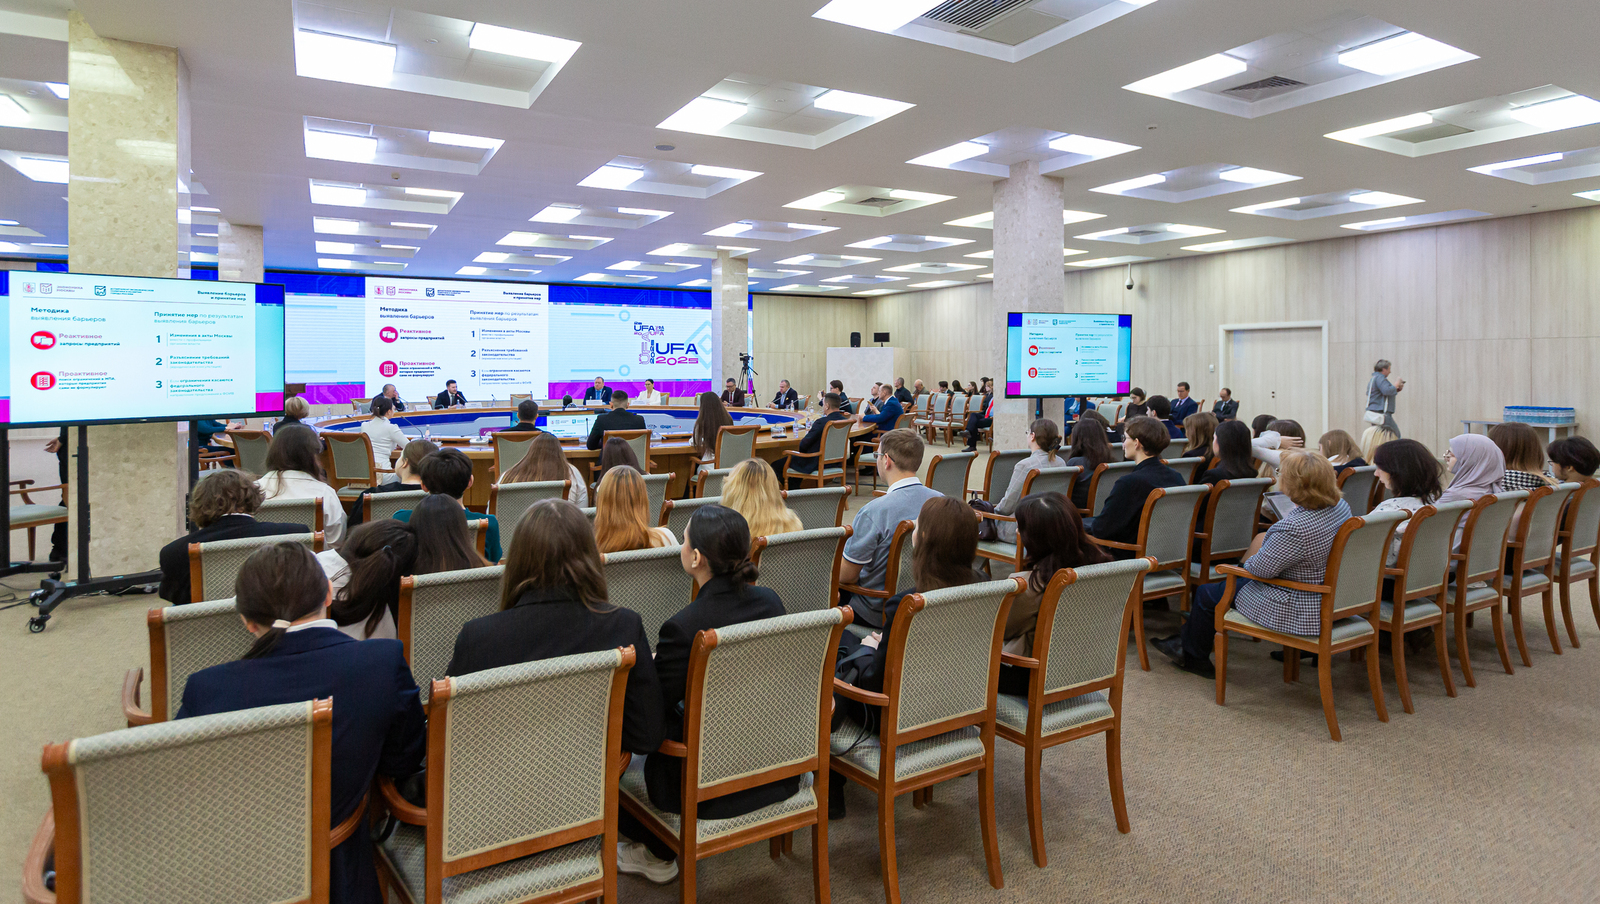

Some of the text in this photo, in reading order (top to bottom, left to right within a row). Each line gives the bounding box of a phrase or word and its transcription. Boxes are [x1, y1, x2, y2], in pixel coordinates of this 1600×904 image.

[156, 335, 160, 343] 1
[656, 343, 698, 354] UFA
[155, 357, 162, 366] 2
[656, 356, 698, 366] 2025
[155, 380, 162, 388] 3
